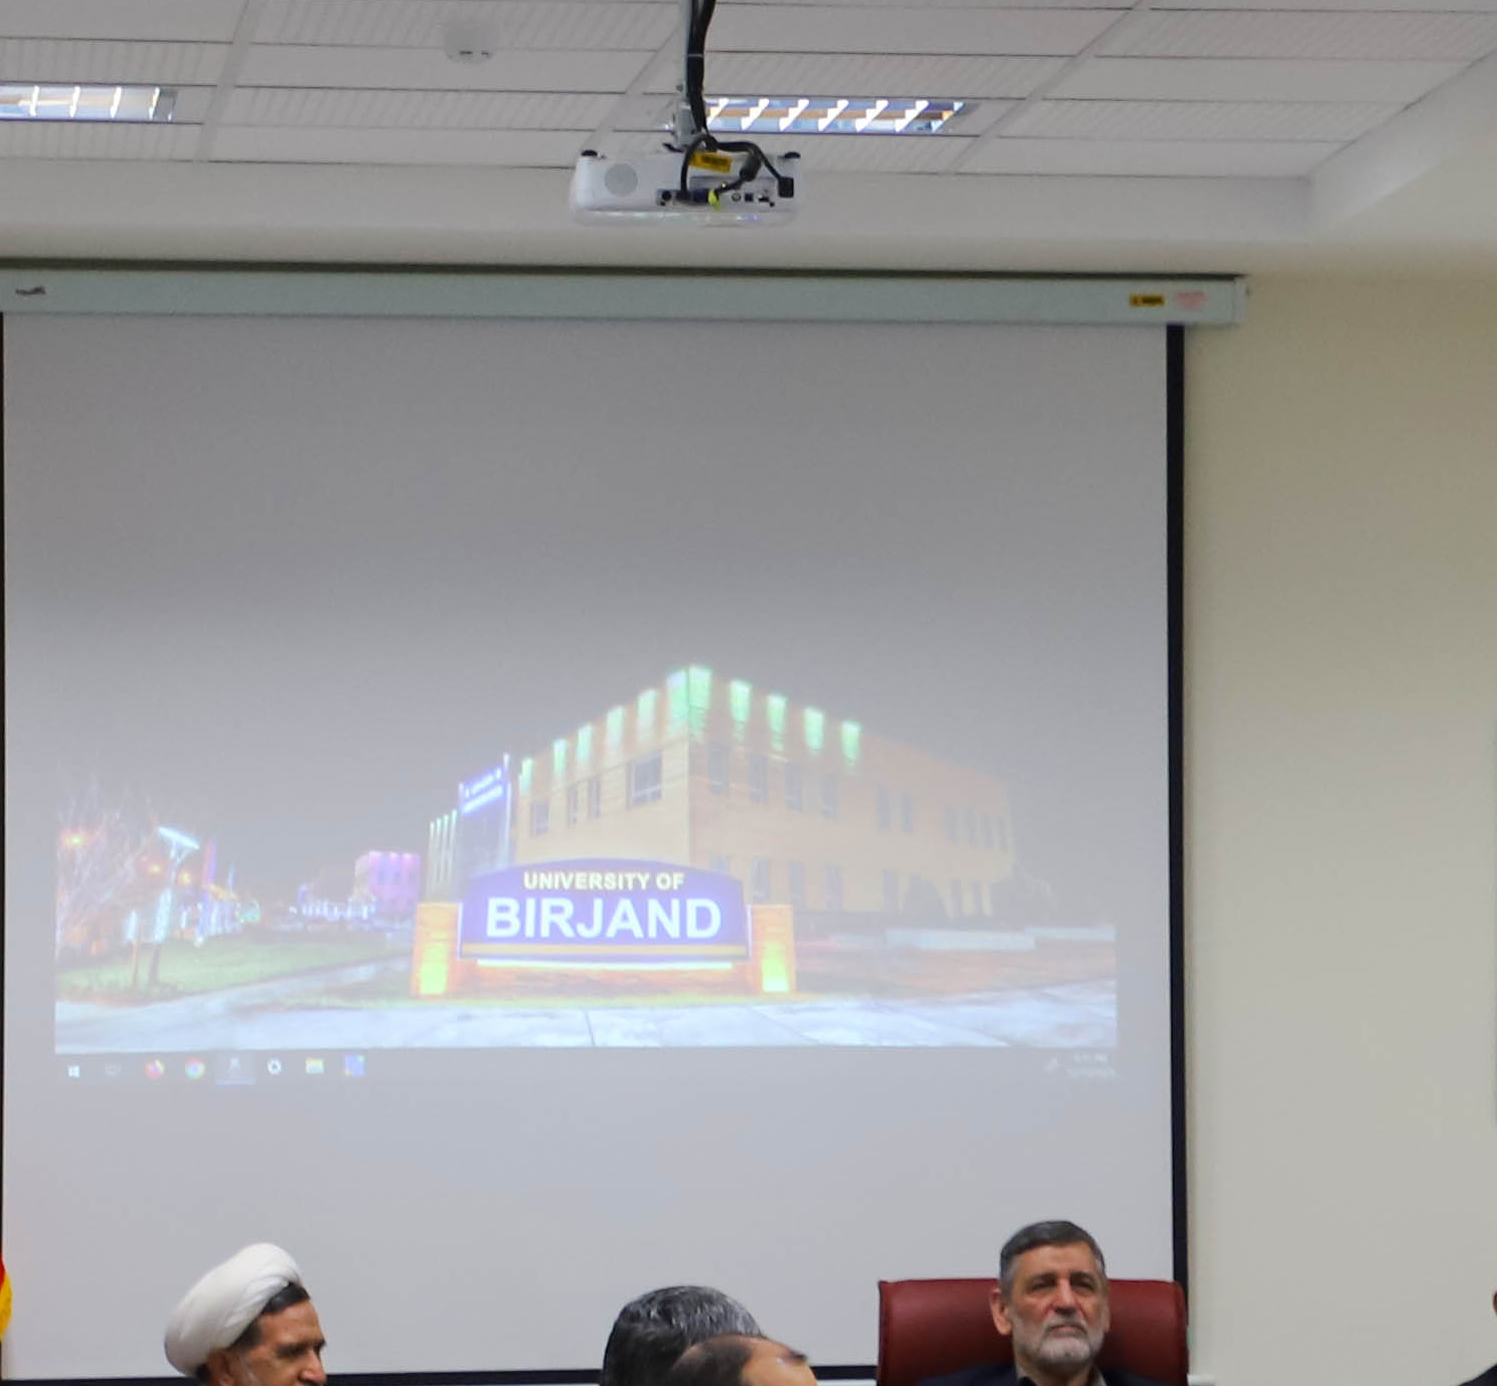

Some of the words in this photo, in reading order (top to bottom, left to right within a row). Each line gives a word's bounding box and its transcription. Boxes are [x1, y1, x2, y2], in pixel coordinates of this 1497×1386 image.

[523, 871, 649, 890] UNIVERSITY
[656, 872, 685, 890] OF
[486, 897, 722, 939] BIRJAND
